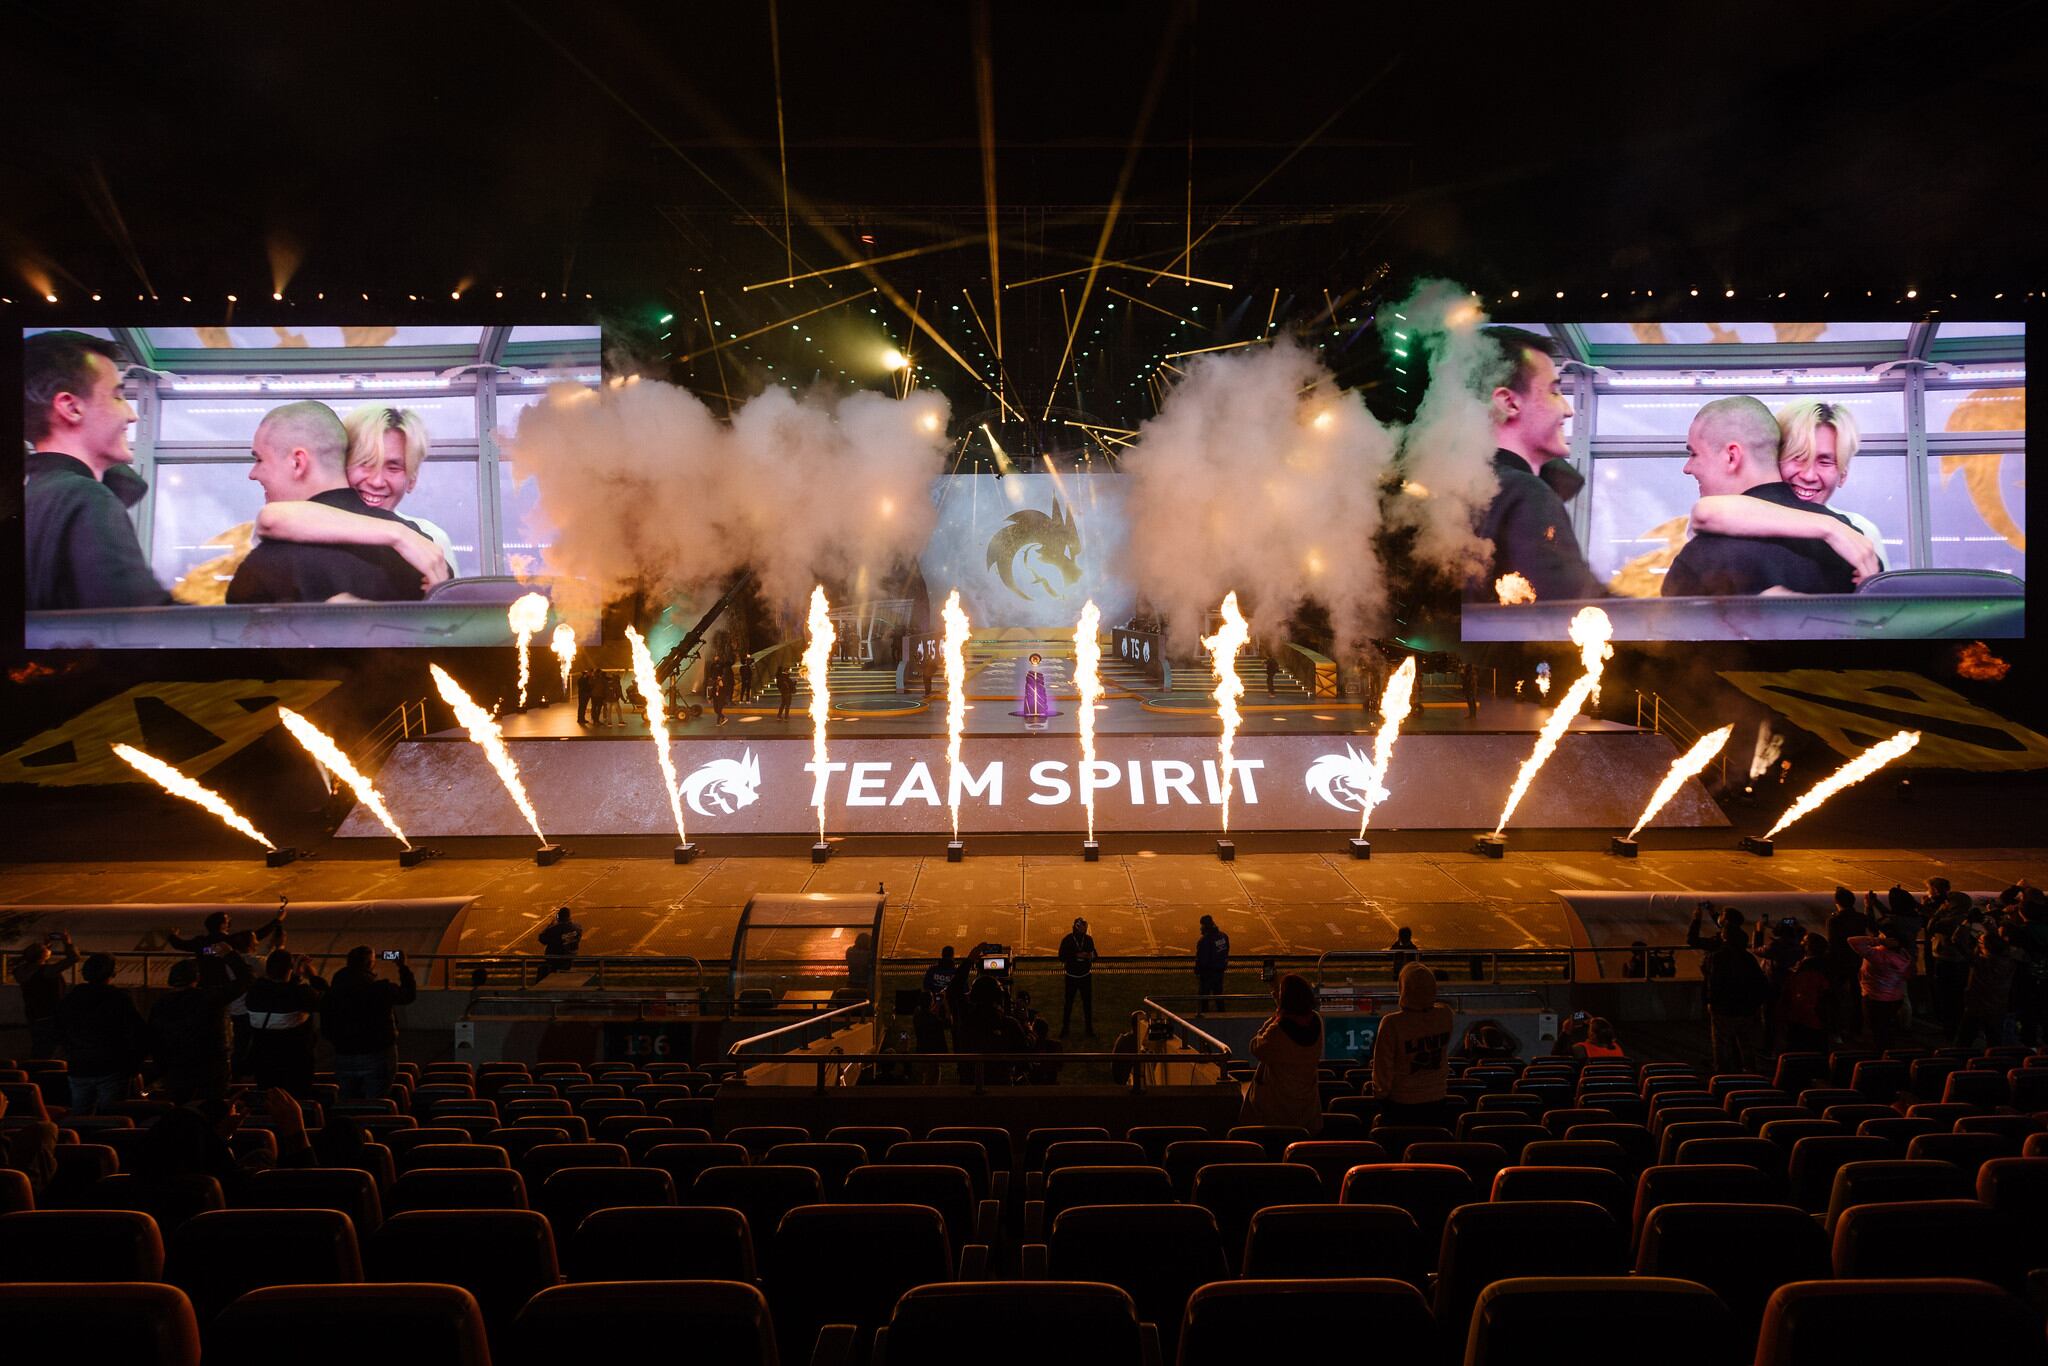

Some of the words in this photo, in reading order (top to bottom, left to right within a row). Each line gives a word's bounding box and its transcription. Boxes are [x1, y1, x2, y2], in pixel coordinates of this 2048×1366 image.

[927, 639, 936, 660] TS
[1131, 638, 1140, 659] TS
[804, 761, 1003, 806] TEAM
[1027, 760, 1265, 805] SPIRIT
[624, 1034, 671, 1057] 136
[1345, 1029, 1375, 1051] 13
